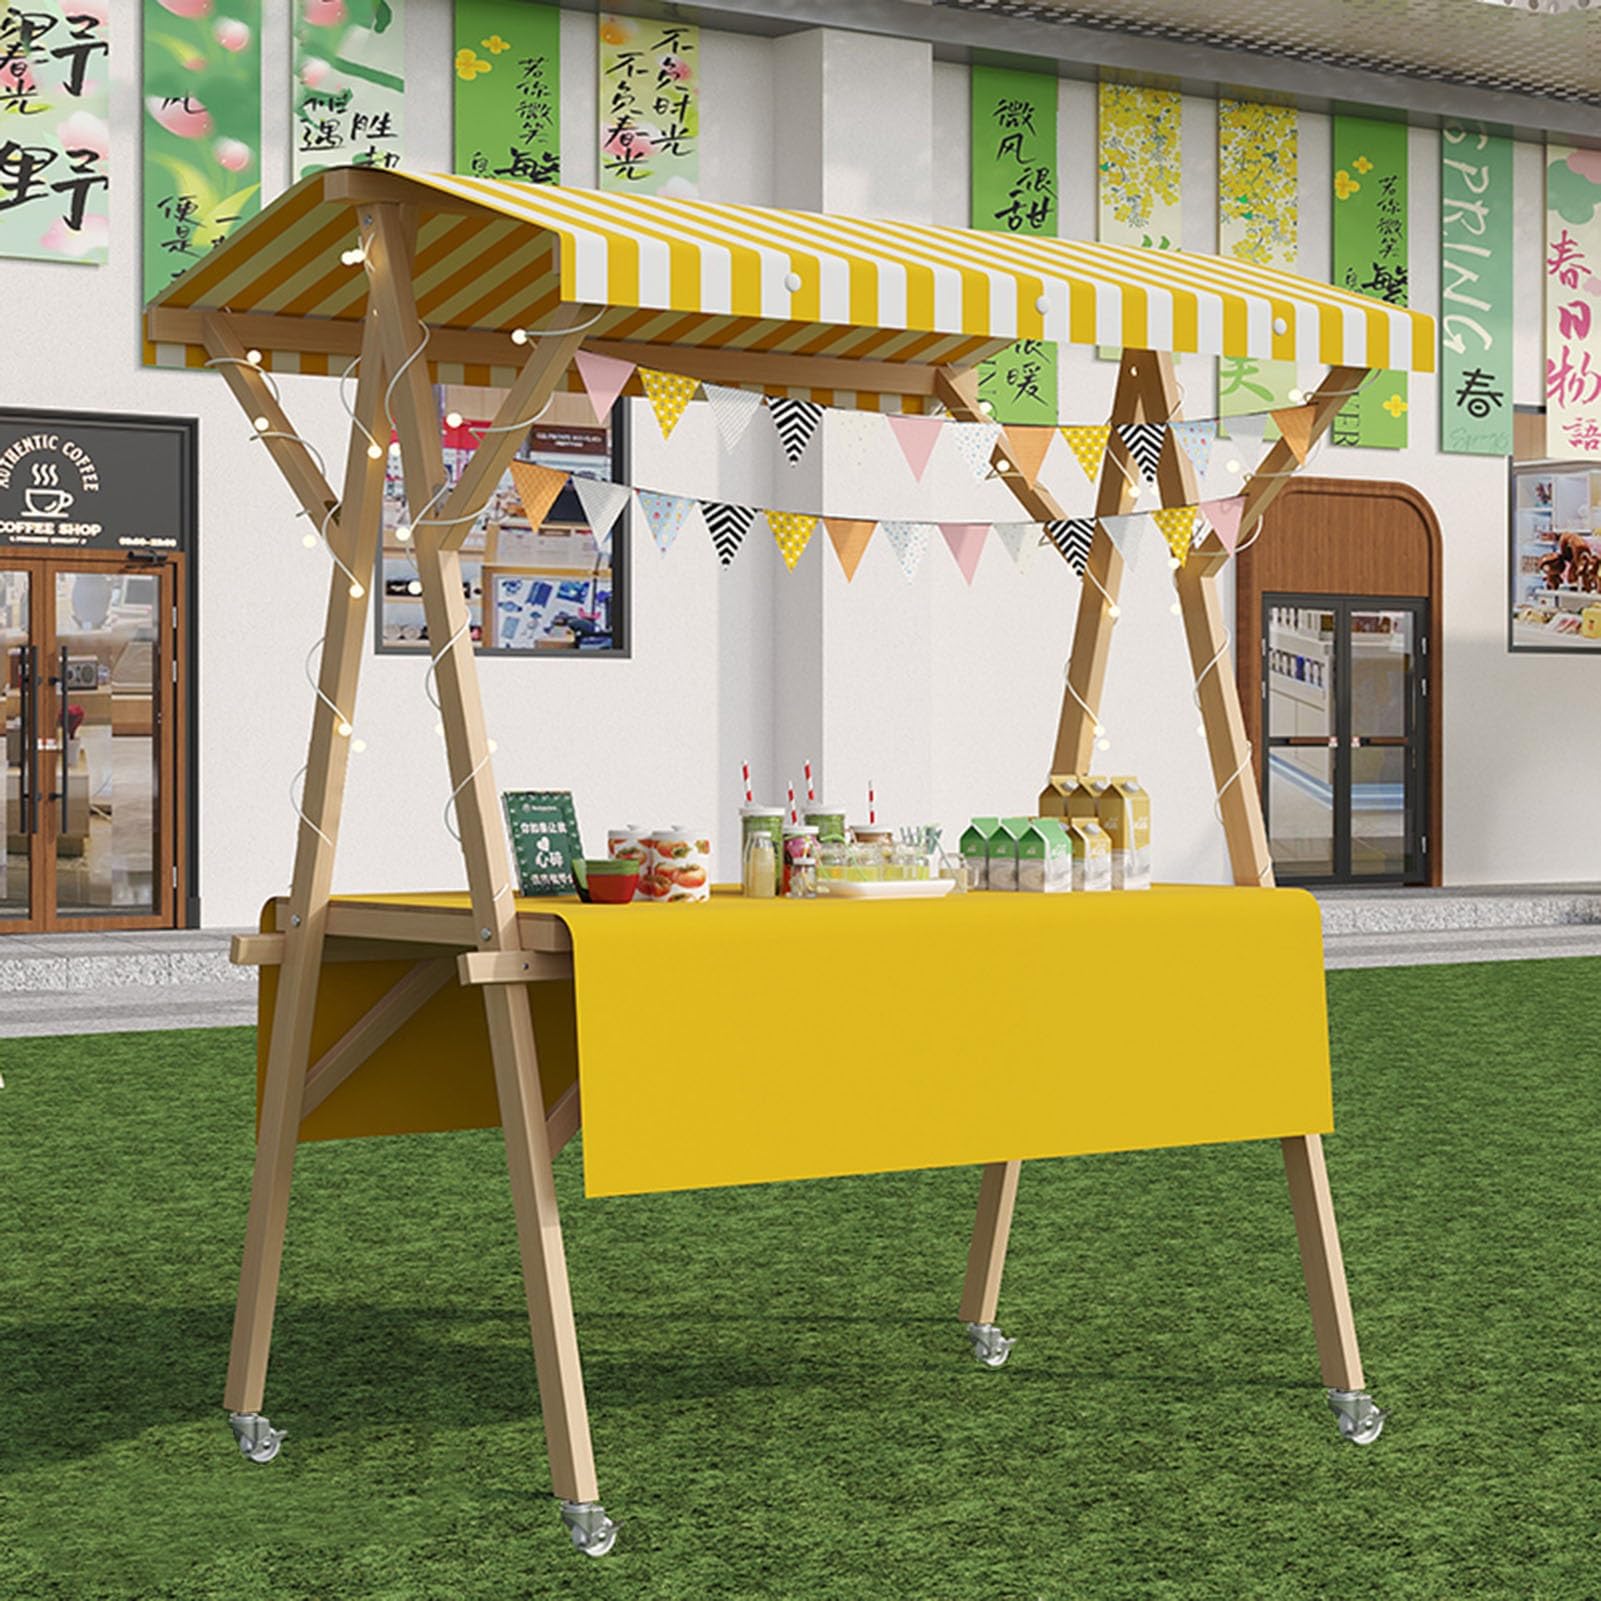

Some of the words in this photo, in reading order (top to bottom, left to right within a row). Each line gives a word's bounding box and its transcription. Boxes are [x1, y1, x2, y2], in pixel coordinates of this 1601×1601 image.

[604, 52, 650, 181] 不负春光
[651, 28, 694, 156] 不负时光
[993, 98, 1057, 231] 微风很甜
[1456, 368, 1504, 418] 春
[62, 441, 99, 492] COFFEE
[58, 523, 102, 537] SHOP
